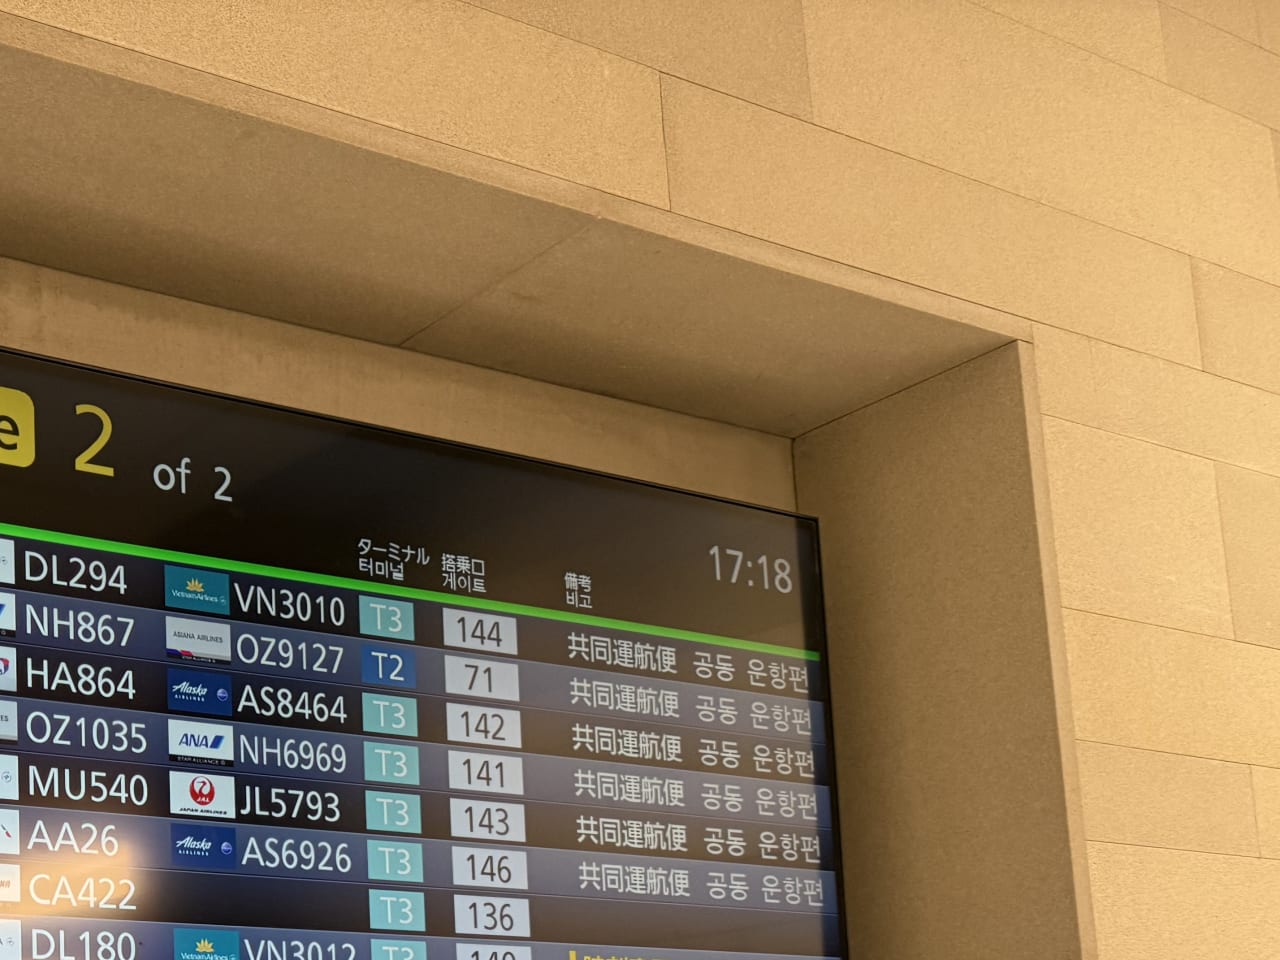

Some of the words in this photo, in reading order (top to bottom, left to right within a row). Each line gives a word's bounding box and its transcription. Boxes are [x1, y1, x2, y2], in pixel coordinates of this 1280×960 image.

[74, 404, 115, 477] 2
[153, 457, 191, 494] of
[214, 467, 233, 502] 2
[357, 538, 430, 566] ターミナル
[359, 558, 404, 581] 터미널
[441, 553, 485, 576] 搭乗口
[709, 545, 793, 593] 17:18
[24, 550, 128, 595] DL294
[442, 572, 487, 593] 게이트
[564, 572, 592, 592] 備考
[233, 582, 345, 627] VN3010
[370, 603, 403, 633] T3
[566, 591, 593, 609] 비고
[25, 603, 135, 647] NH867
[456, 616, 503, 648] 144
[236, 633, 344, 674] OZ9127
[371, 651, 404, 682] T2
[26, 657, 136, 700] HA864
[463, 663, 493, 693] 71
[236, 684, 348, 724] AS8464
[25, 710, 147, 754] OZ1035
[460, 710, 506, 741] 142
[239, 734, 347, 774] NH6969
[28, 764, 149, 807] MU540
[239, 785, 341, 823] JL5793
[27, 819, 119, 857] AA26
[575, 815, 688, 853] 共同運航便
[703, 826, 747, 857] 공동
[757, 830, 821, 864] 운항편
[241, 836, 352, 873] AS6926
[378, 847, 412, 875] T3
[466, 853, 512, 884] 146
[29, 873, 136, 911] CA422
[468, 901, 514, 932] 136
